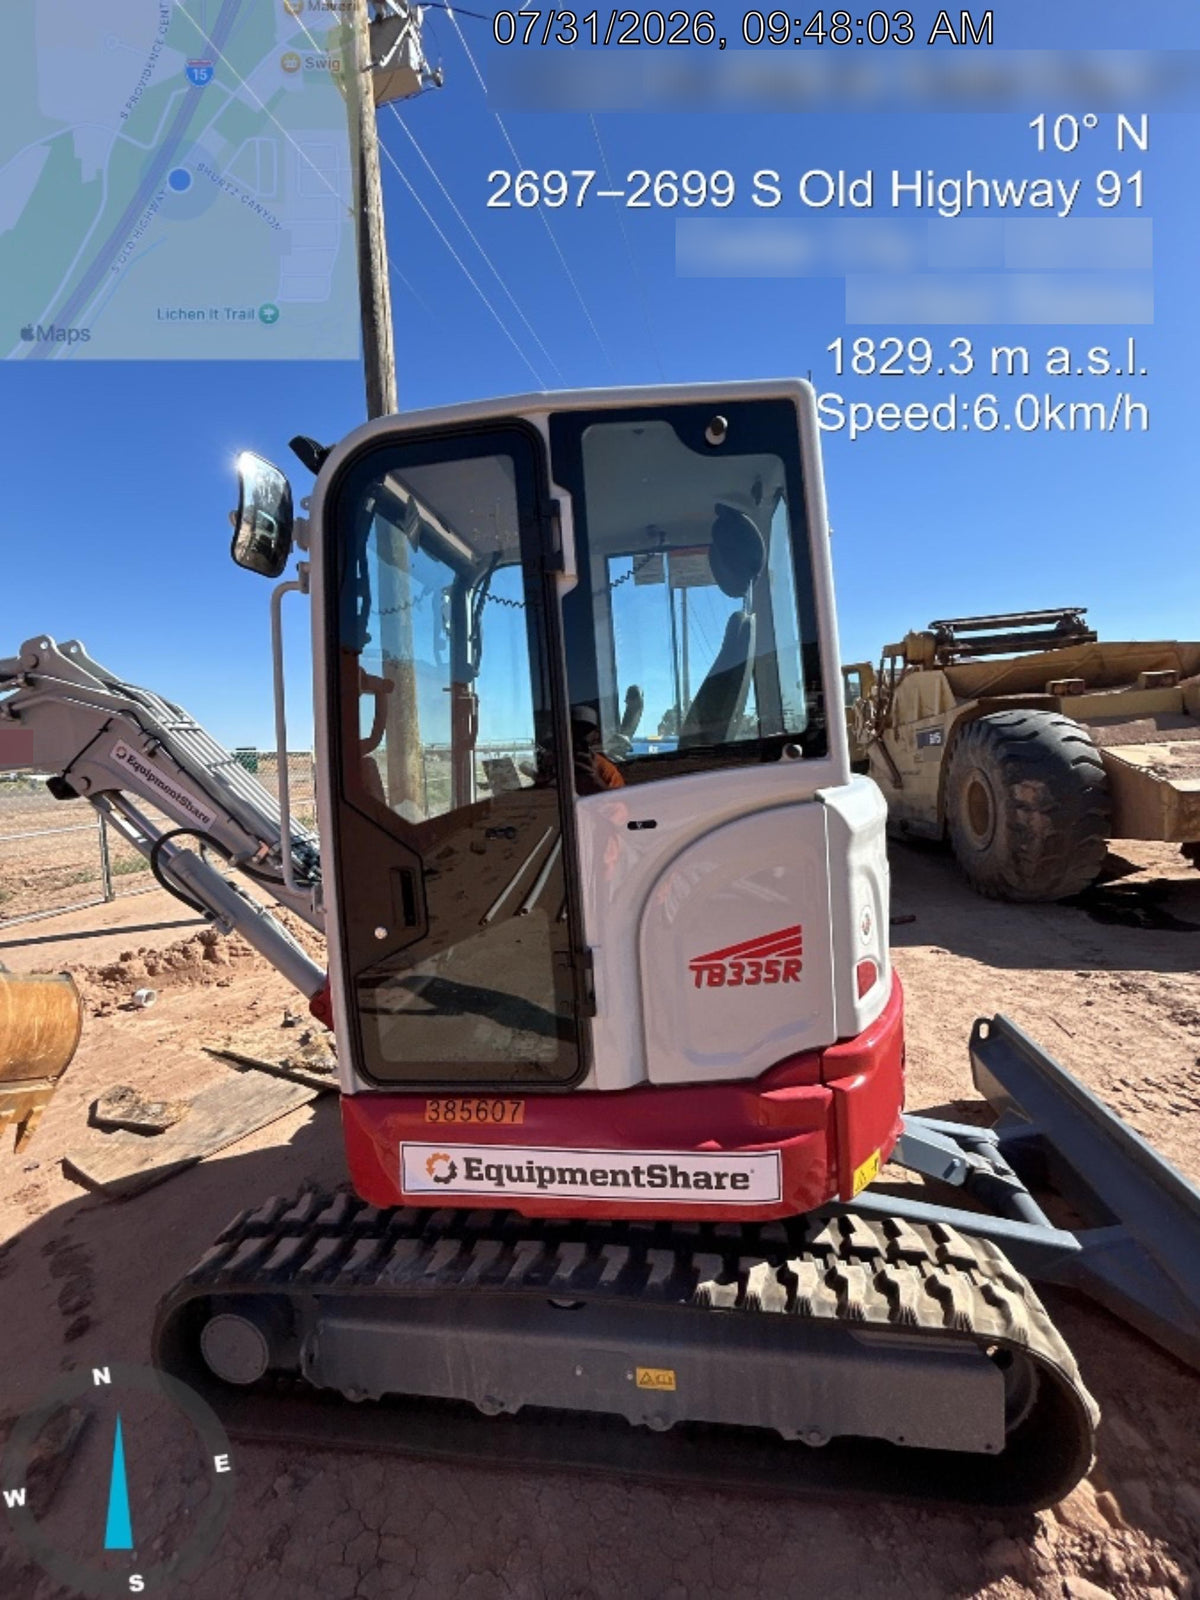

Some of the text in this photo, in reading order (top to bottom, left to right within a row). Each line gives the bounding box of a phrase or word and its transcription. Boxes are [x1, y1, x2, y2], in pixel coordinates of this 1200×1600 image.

[126, 754, 211, 824] EquipmentShare
[688, 958, 803, 989] TB335R
[428, 1099, 522, 1122] 385607
[462, 1156, 751, 1190] EquipmentShare
